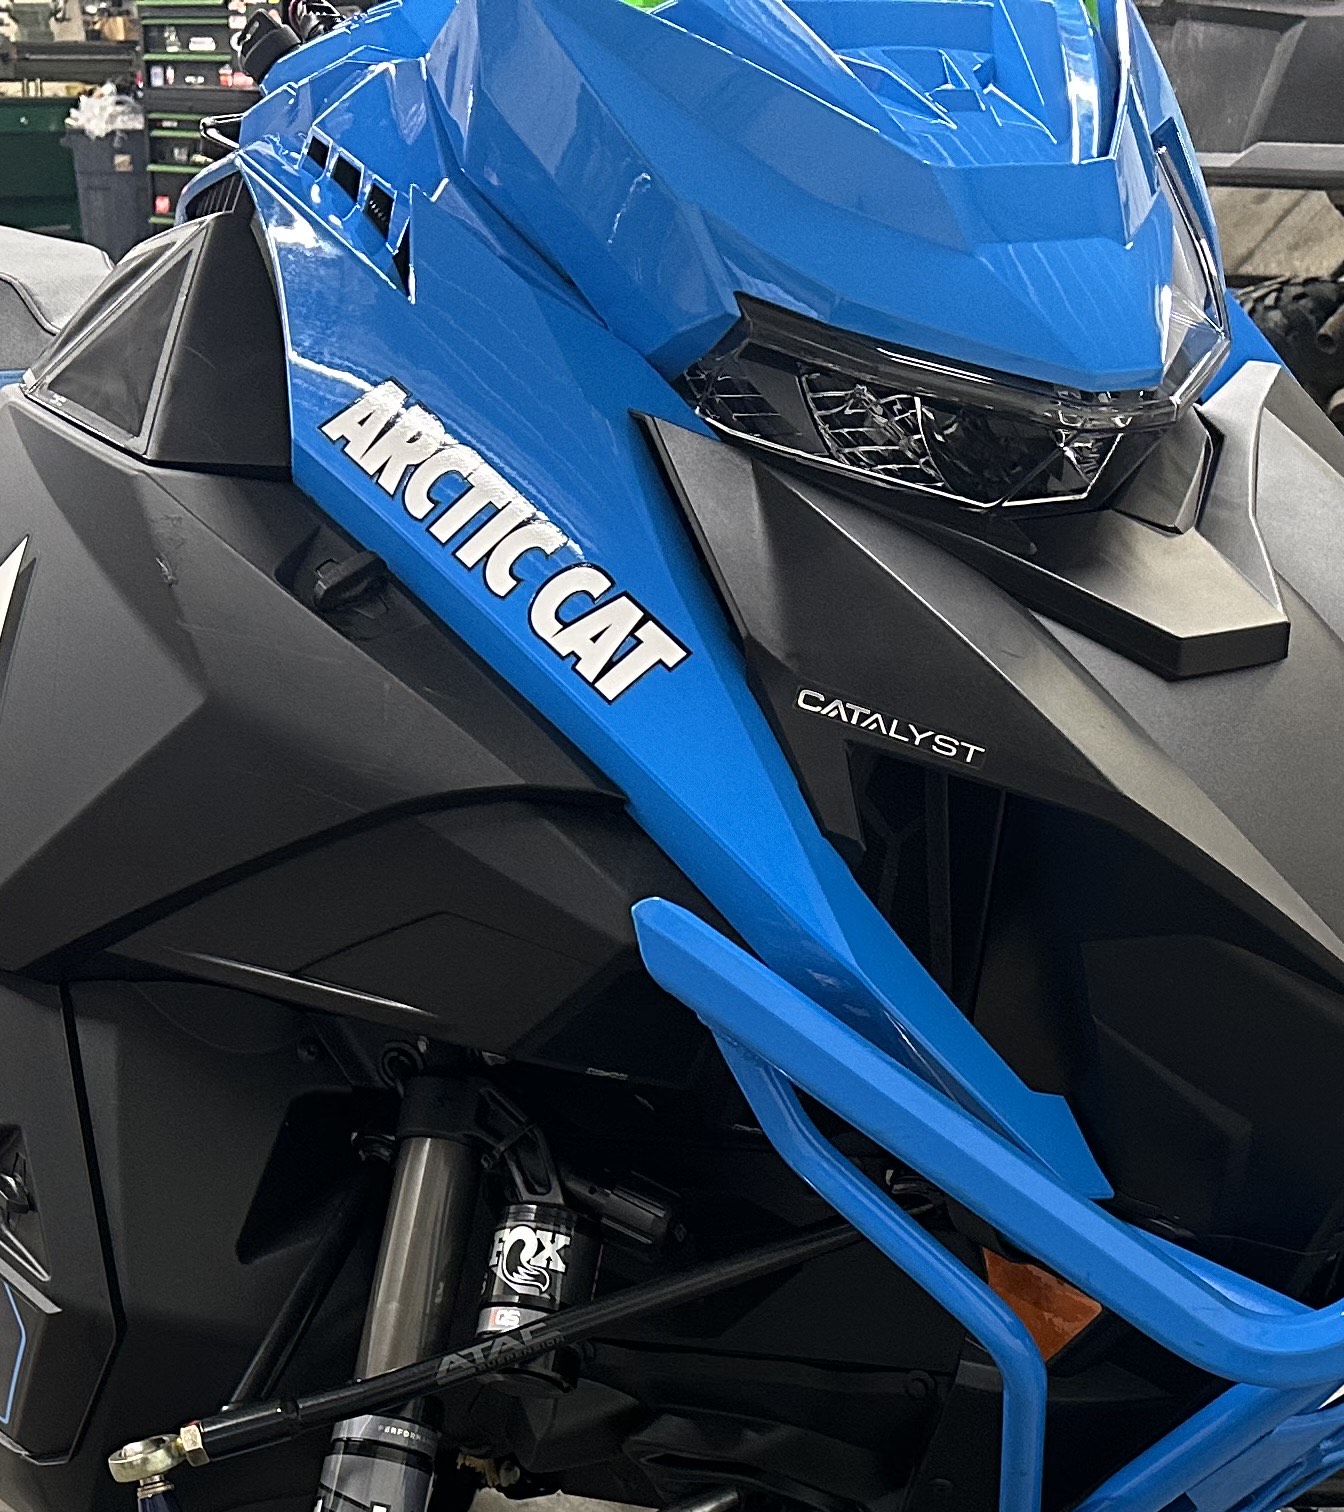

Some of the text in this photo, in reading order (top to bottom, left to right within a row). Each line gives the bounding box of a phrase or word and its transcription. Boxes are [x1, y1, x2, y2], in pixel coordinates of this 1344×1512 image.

[318, 377, 692, 704] ARCTIC CAT
[797, 689, 986, 763] CATALYST
[489, 1224, 571, 1294] FOX
